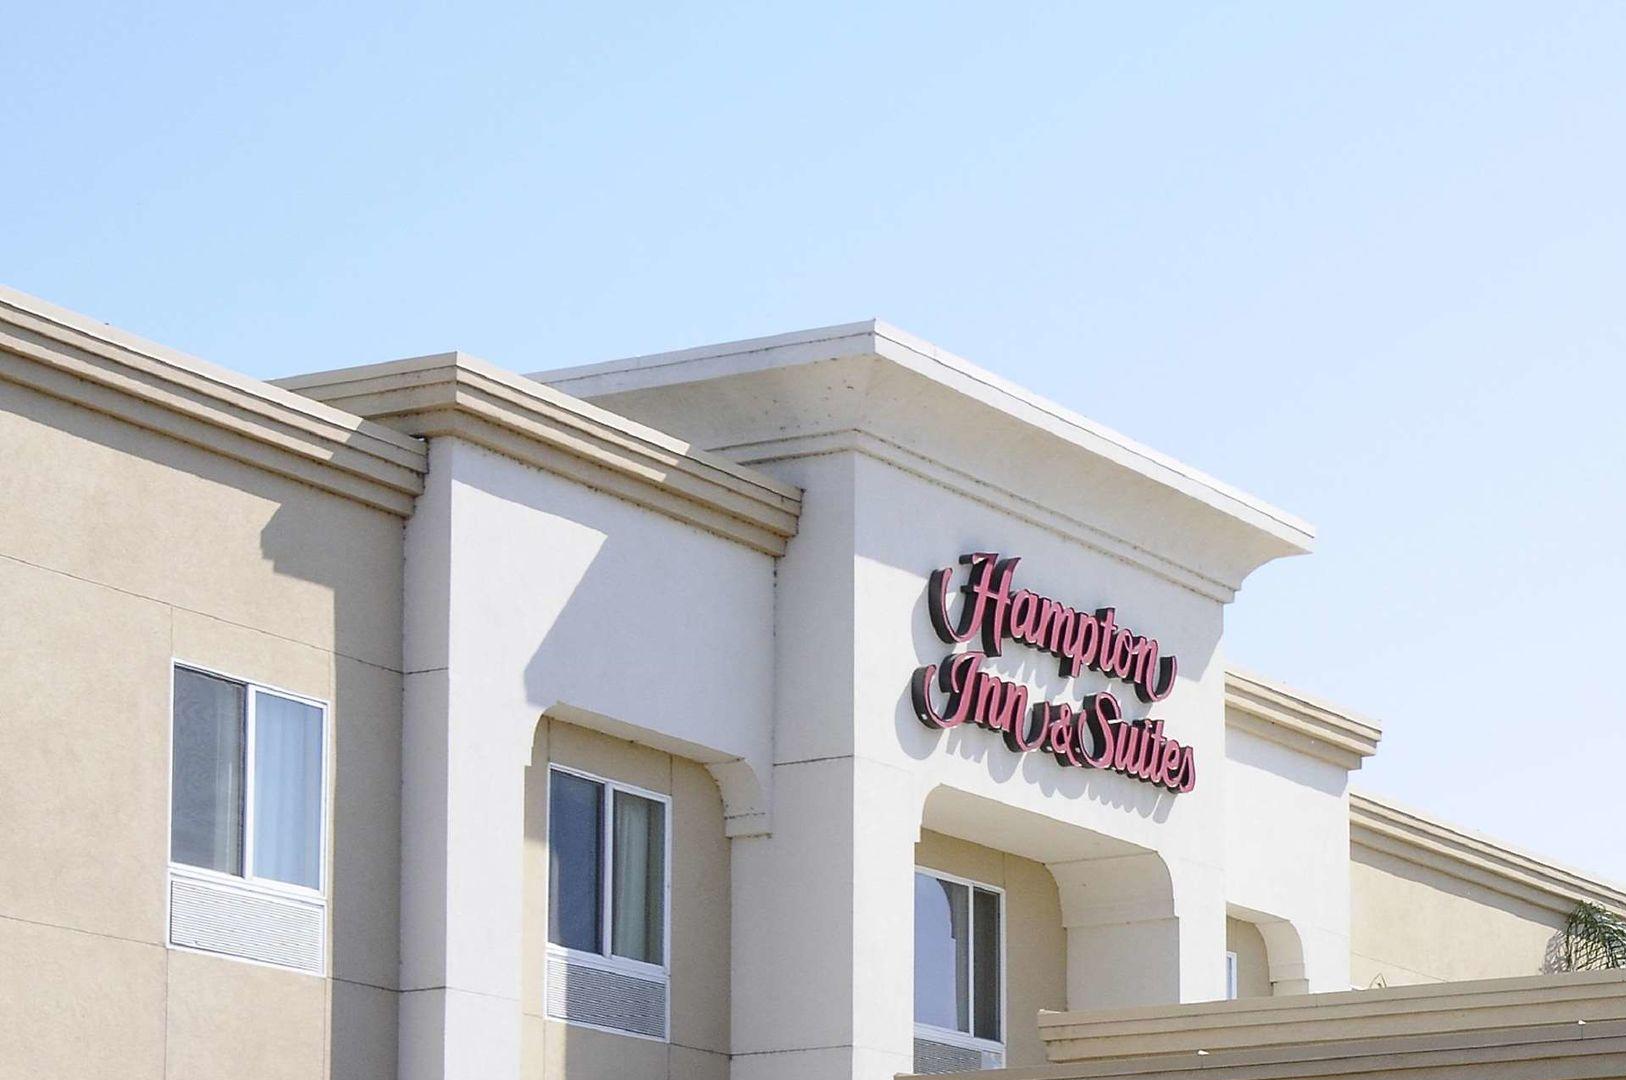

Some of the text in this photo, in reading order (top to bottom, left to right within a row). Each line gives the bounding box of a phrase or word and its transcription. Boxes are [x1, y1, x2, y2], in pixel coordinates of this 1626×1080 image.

[928, 553, 1178, 703] Hampton
[911, 651, 1196, 794] Inn & Suites
